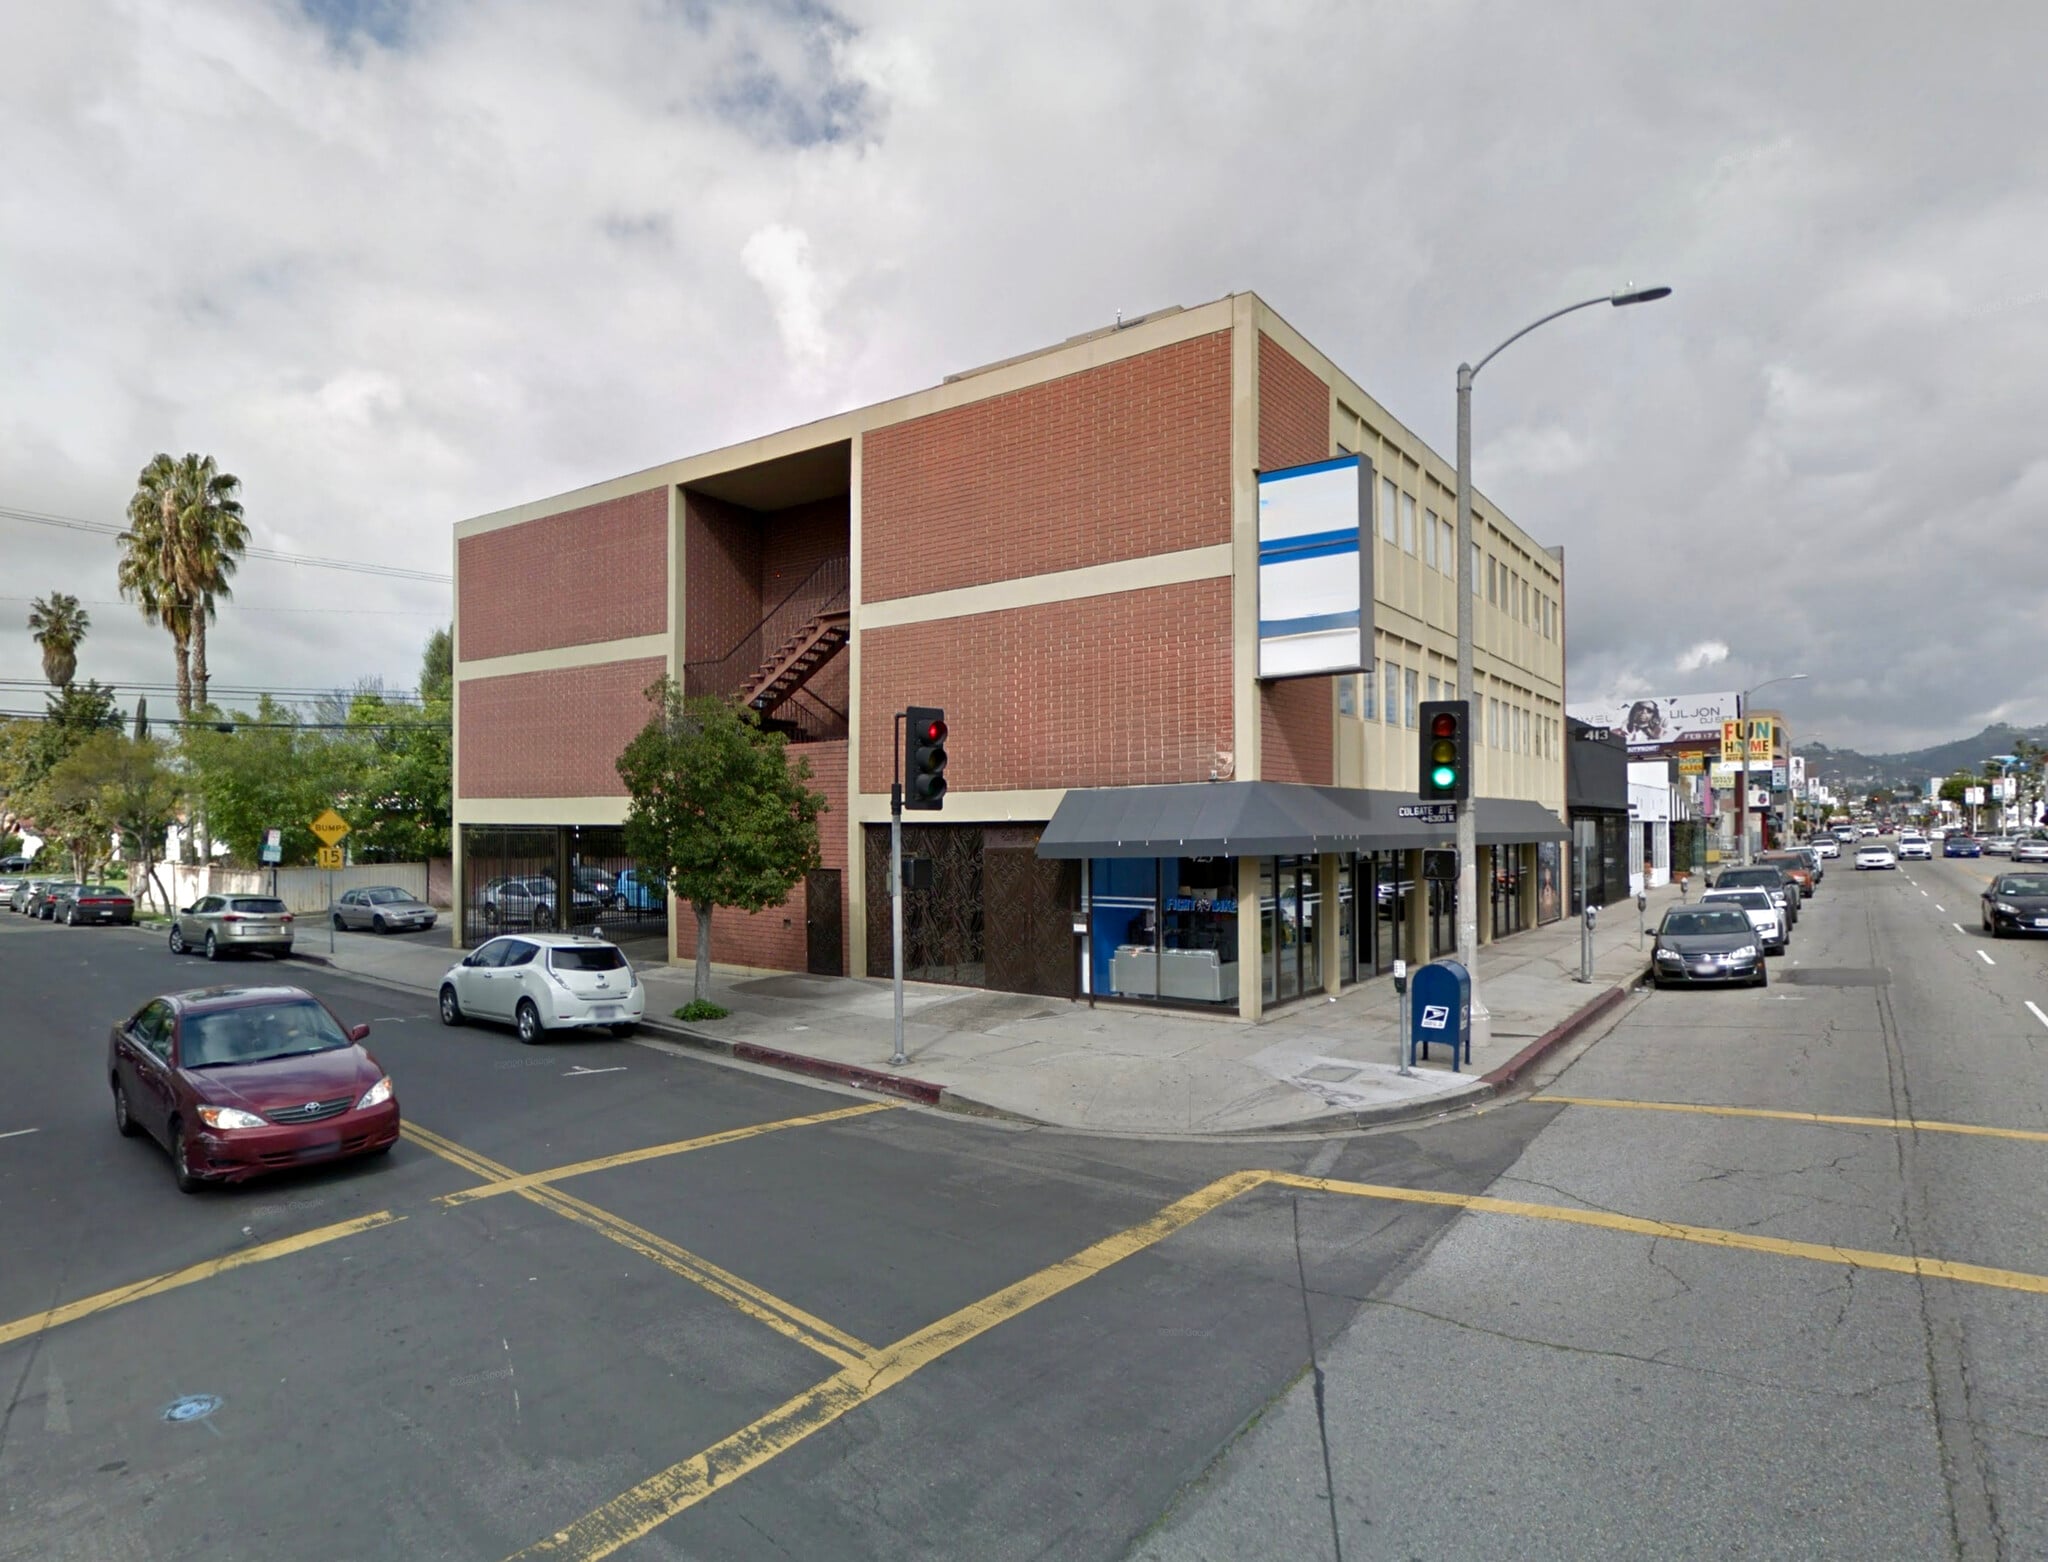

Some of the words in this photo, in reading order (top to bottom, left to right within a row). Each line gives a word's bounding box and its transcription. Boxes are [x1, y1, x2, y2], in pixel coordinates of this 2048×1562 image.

[1579, 714, 1613, 723] WEL
[1670, 709, 1688, 719] LIL
[1690, 707, 1721, 718] JON
[1584, 730, 1609, 741] 413
[1724, 721, 1770, 740] FUN
[1399, 806, 1434, 816] COLGATE
[315, 824, 347, 832] BUMPS
[323, 850, 340, 863] 15
